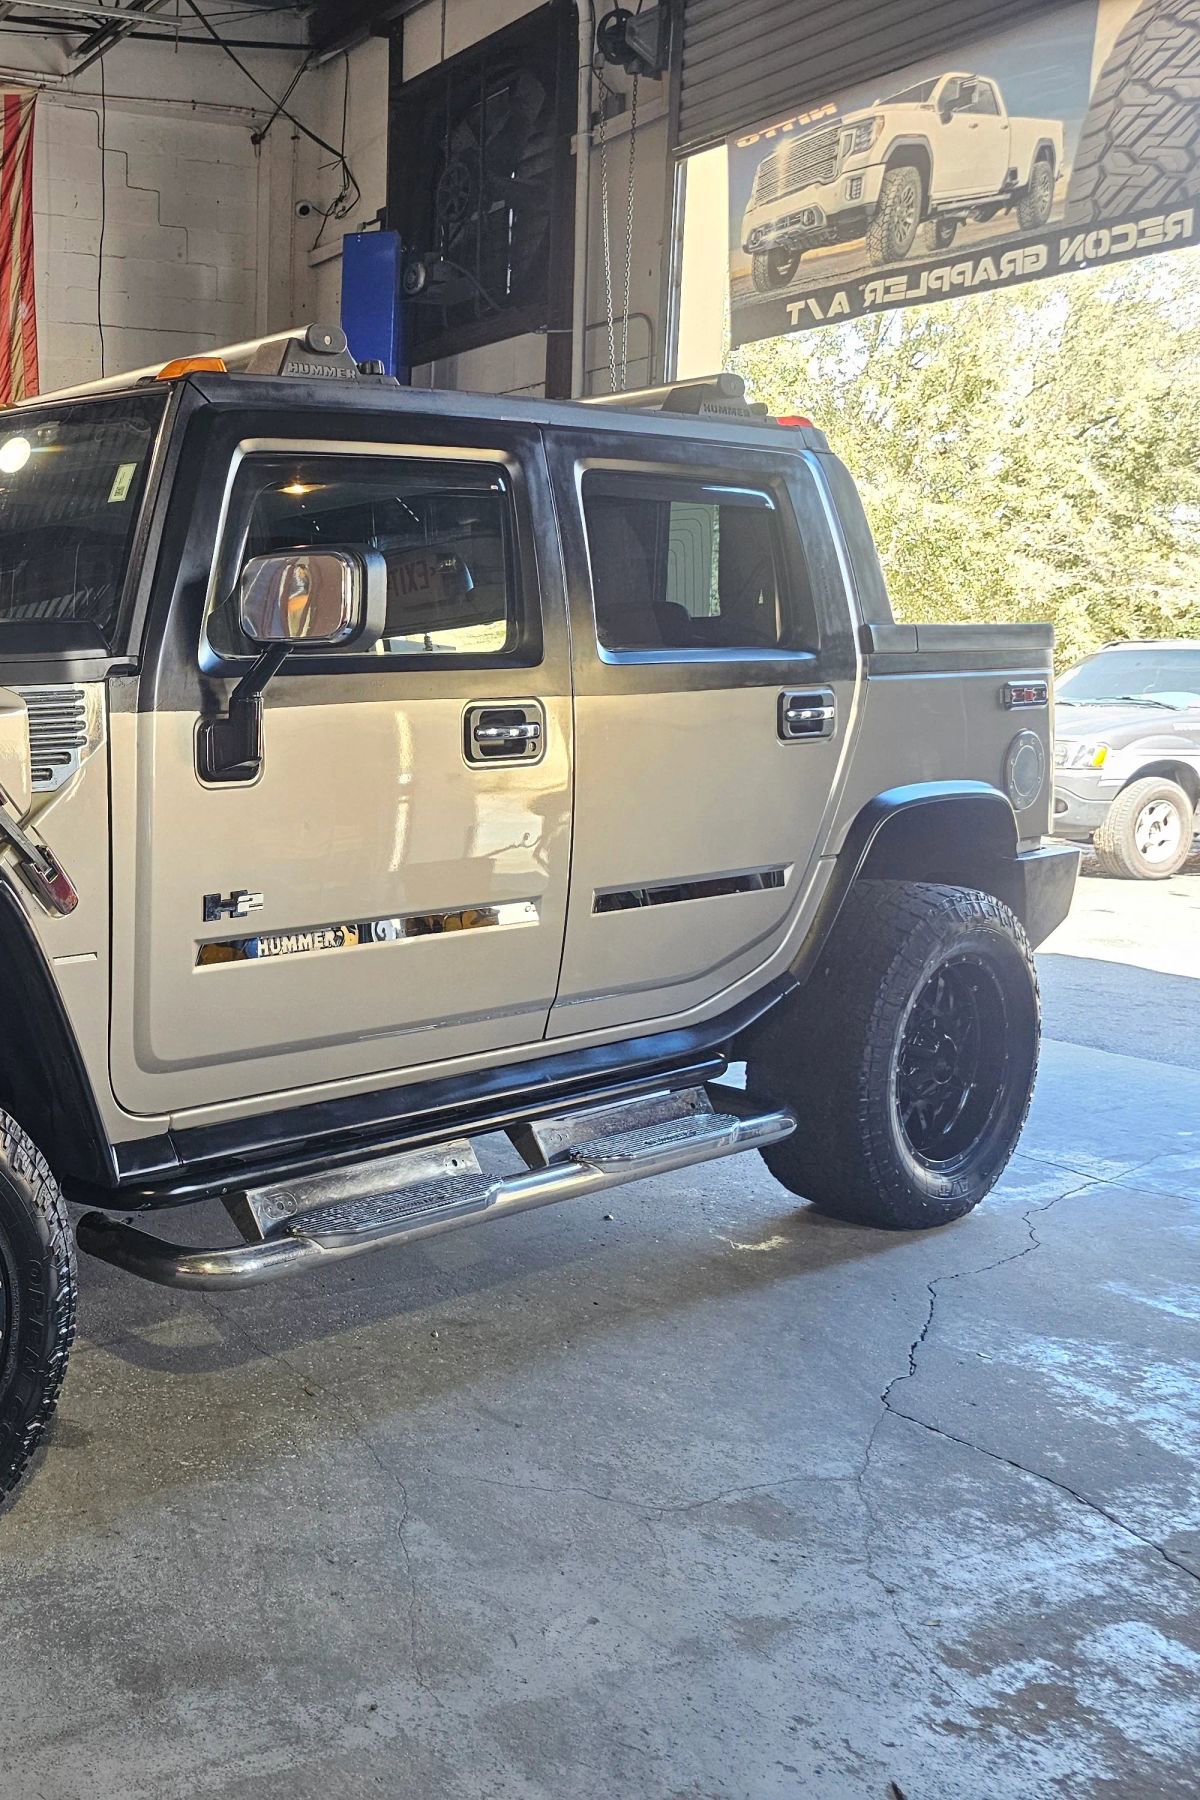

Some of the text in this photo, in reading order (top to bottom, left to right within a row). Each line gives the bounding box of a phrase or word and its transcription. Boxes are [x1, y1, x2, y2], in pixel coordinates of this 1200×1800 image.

[287, 361, 357, 380] HUMMER
[702, 402, 752, 418] HUMMER
[202, 889, 265, 923] H2
[257, 929, 338, 958] HUMMER
